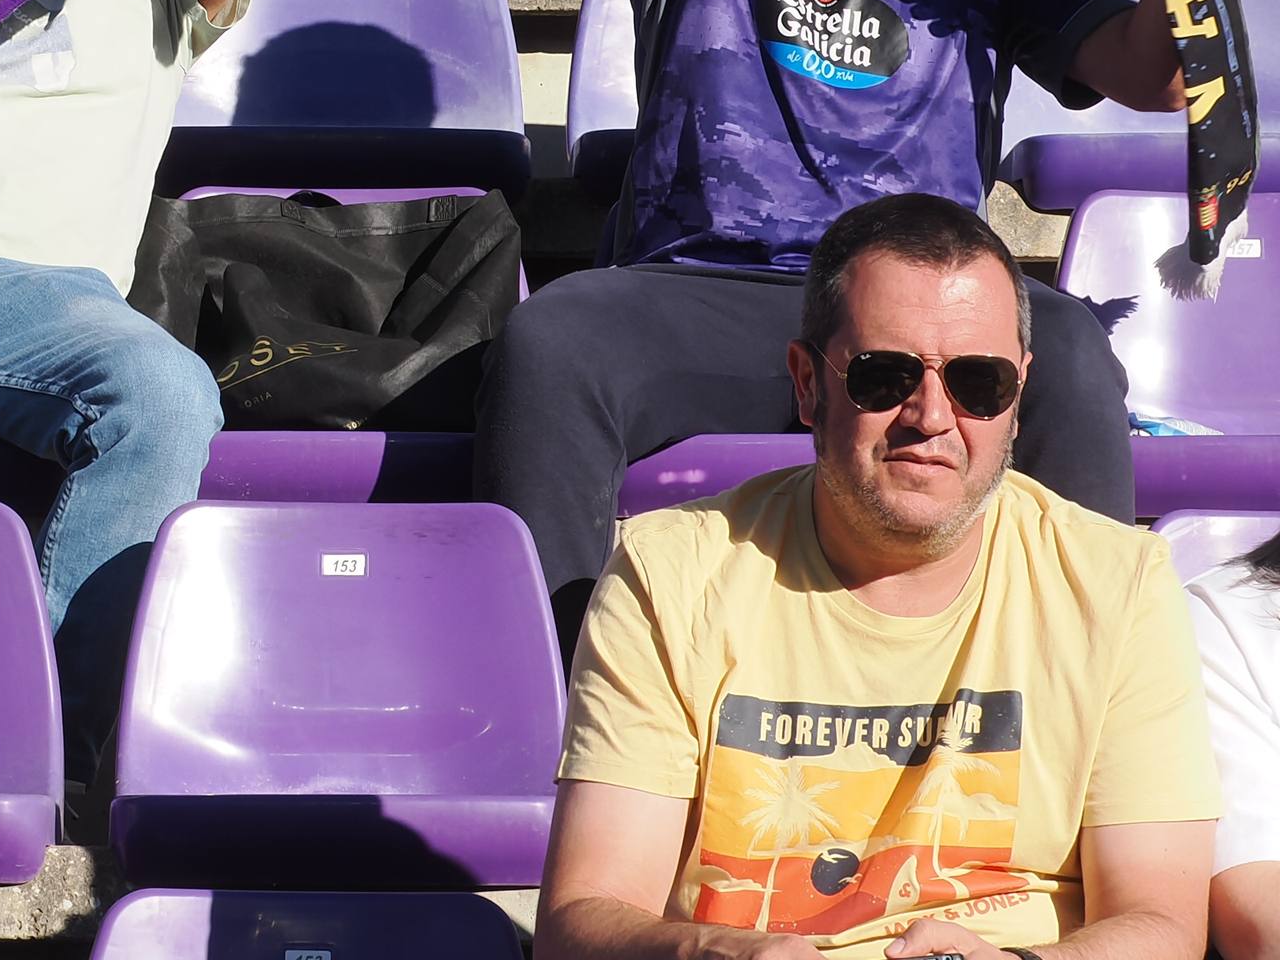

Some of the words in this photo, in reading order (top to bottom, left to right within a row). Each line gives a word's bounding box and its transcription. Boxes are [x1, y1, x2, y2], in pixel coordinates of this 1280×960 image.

[777, 7, 872, 68] Galicia
[333, 560, 356, 572] 153
[759, 711, 890, 749] FOREVER
[943, 908, 960, 921] &
[964, 892, 1030, 918] JONES
